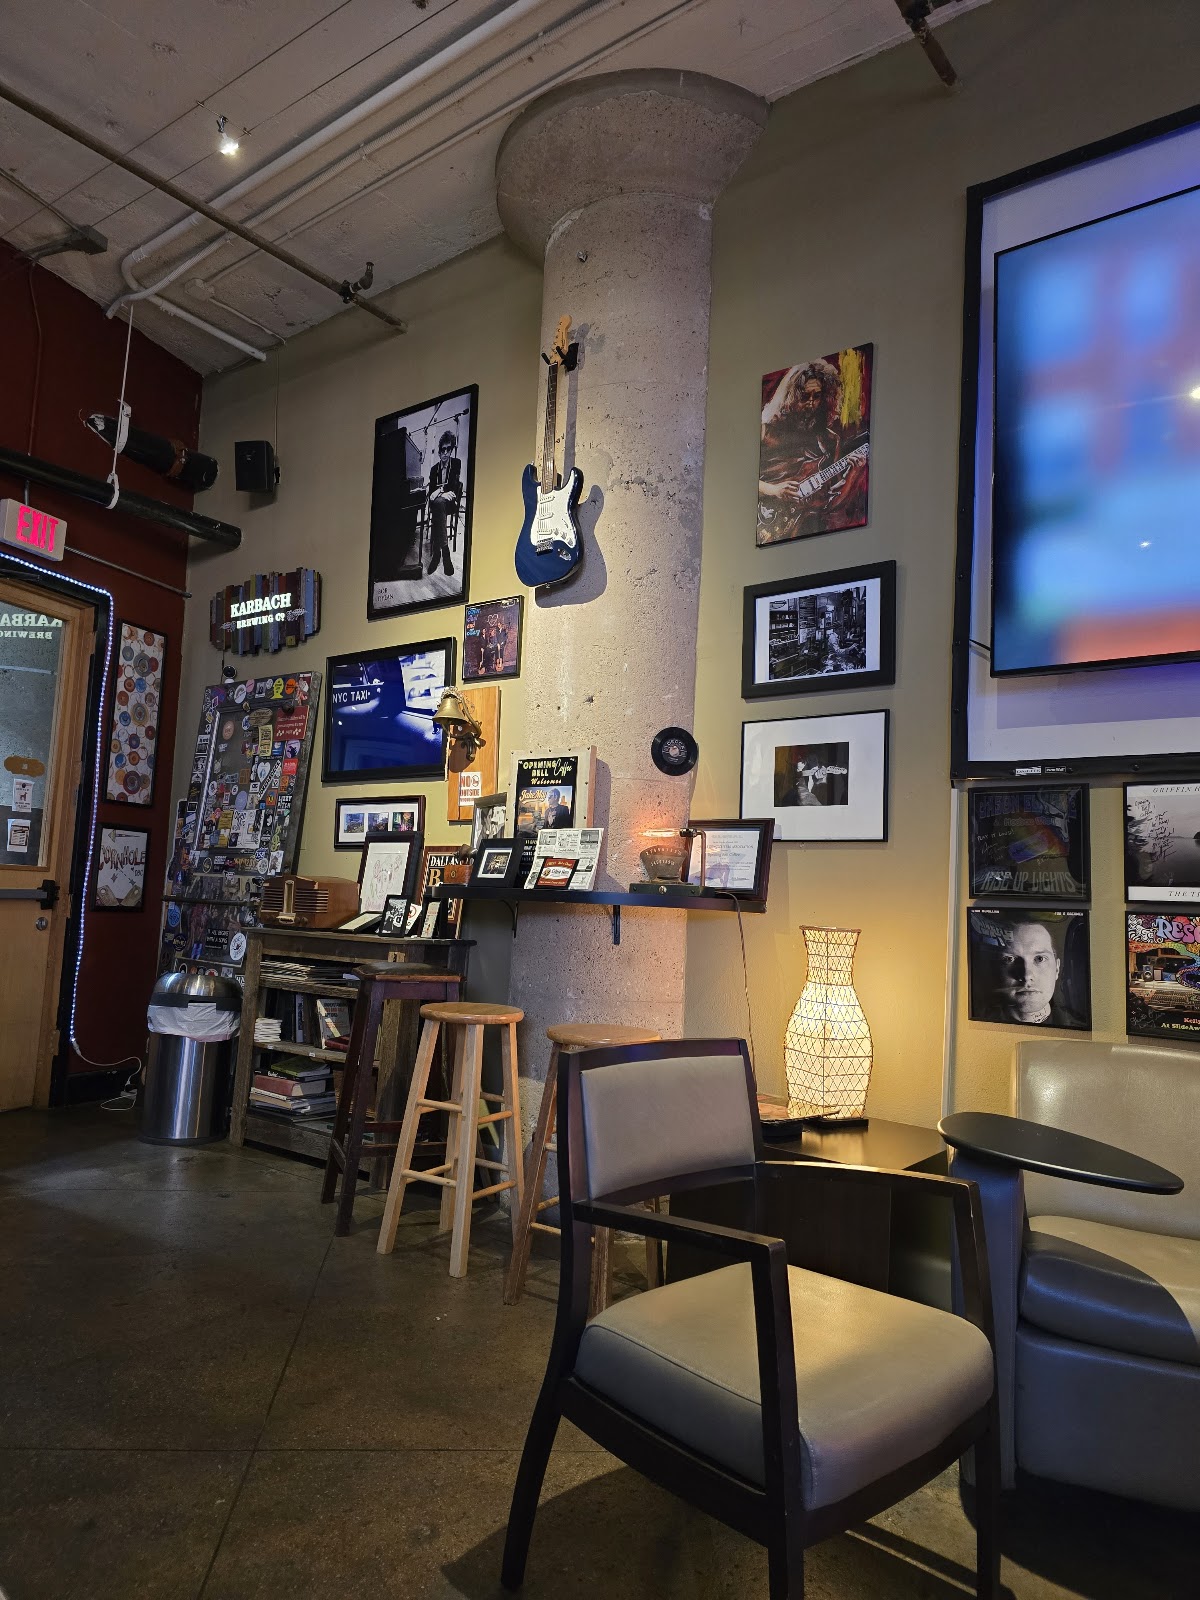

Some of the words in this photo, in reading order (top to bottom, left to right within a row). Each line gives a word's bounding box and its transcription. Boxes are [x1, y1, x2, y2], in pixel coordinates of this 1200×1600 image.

[16, 505, 59, 553] EXIT
[230, 593, 292, 618] KARBACH
[236, 614, 274, 629] BREWING
[332, 692, 348, 704] NYC
[350, 690, 368, 702] TAXI
[523, 760, 557, 770] OPENING
[553, 758, 573, 777] Coffee
[460, 775, 471, 788] NO
[1152, 786, 1192, 794] GRIFFIN
[1012, 871, 1030, 892] UP
[1030, 871, 1077, 893] LIGHTS
